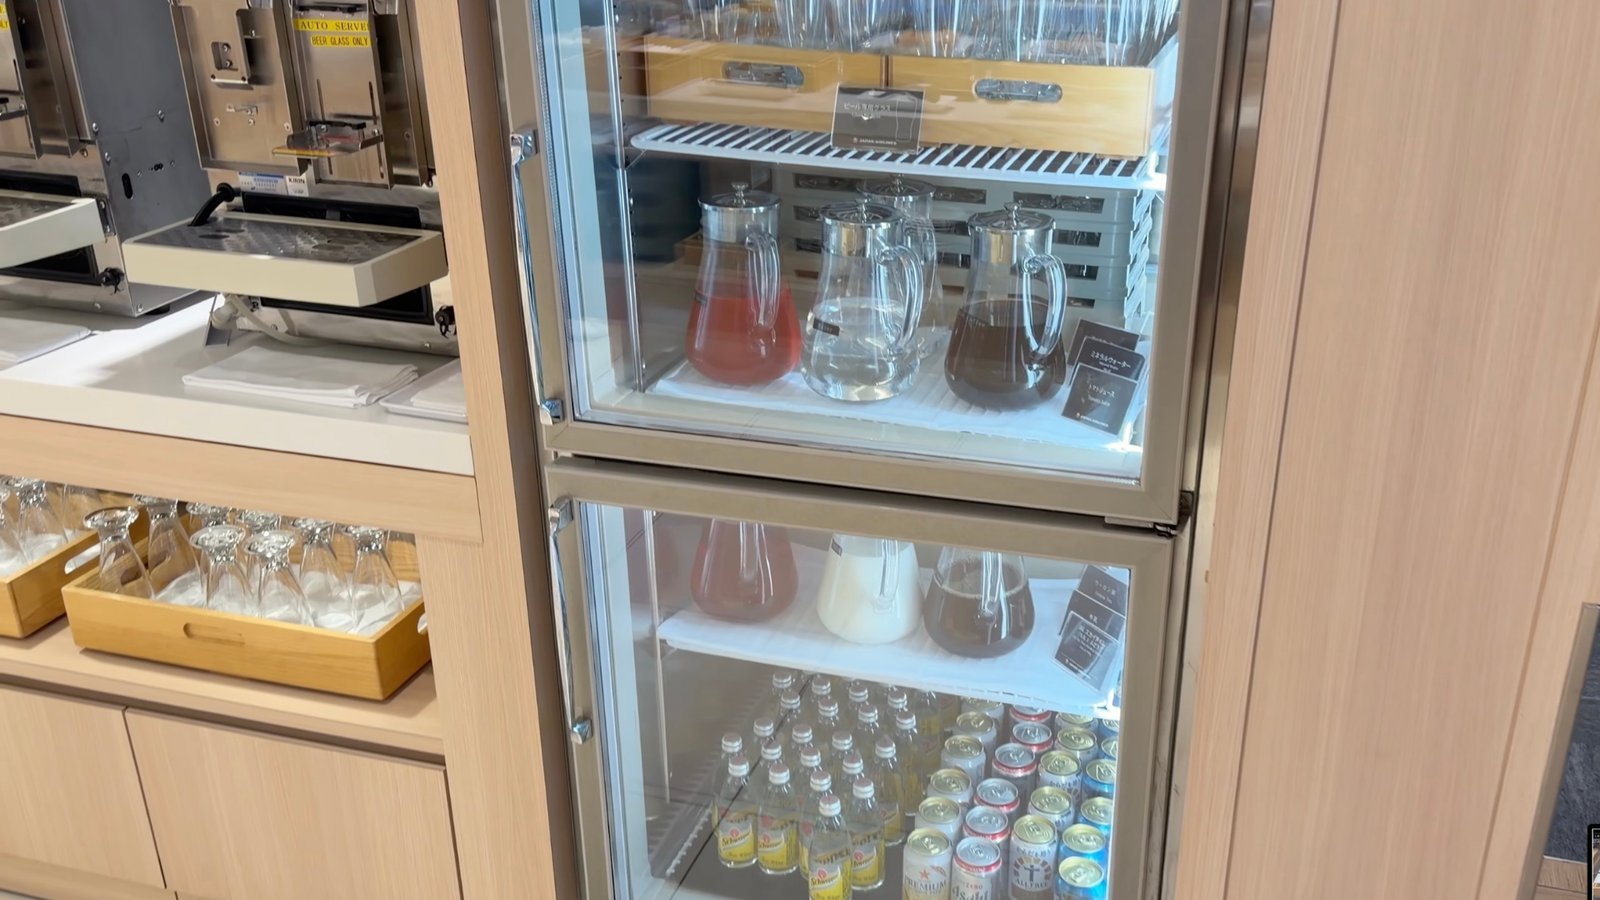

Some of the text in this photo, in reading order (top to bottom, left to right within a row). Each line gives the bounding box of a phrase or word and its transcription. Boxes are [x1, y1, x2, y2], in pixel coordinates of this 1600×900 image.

[301, 21, 369, 31] AUTO SERVE
[311, 36, 368, 46] BEER GLASS ONLY
[905, 875, 947, 892] PREMIUM
